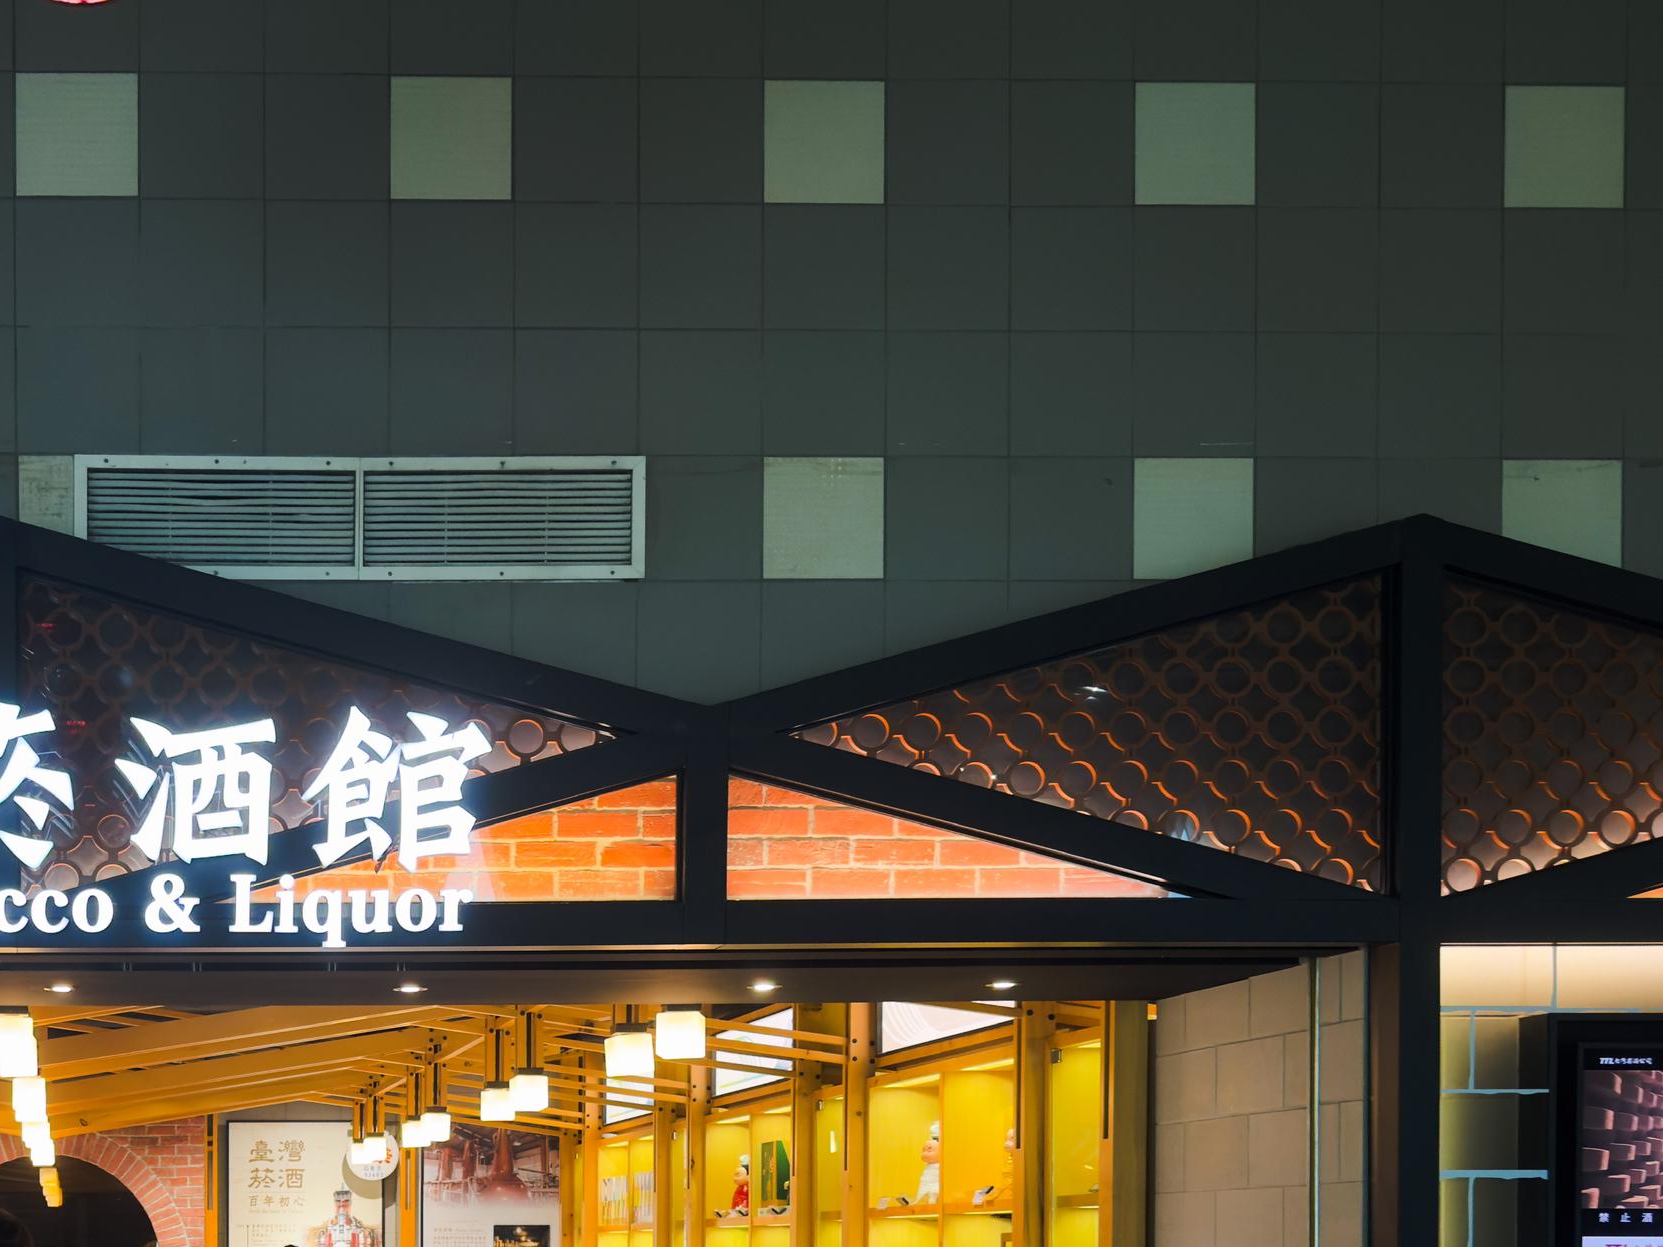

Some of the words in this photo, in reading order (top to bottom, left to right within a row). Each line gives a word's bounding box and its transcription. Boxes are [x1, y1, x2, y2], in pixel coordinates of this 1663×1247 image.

[145, 875, 201, 934] &
[229, 873, 475, 948] Liquor
[248, 1168, 306, 1189] 菸酒
[250, 1195, 305, 1207] 百年初心
